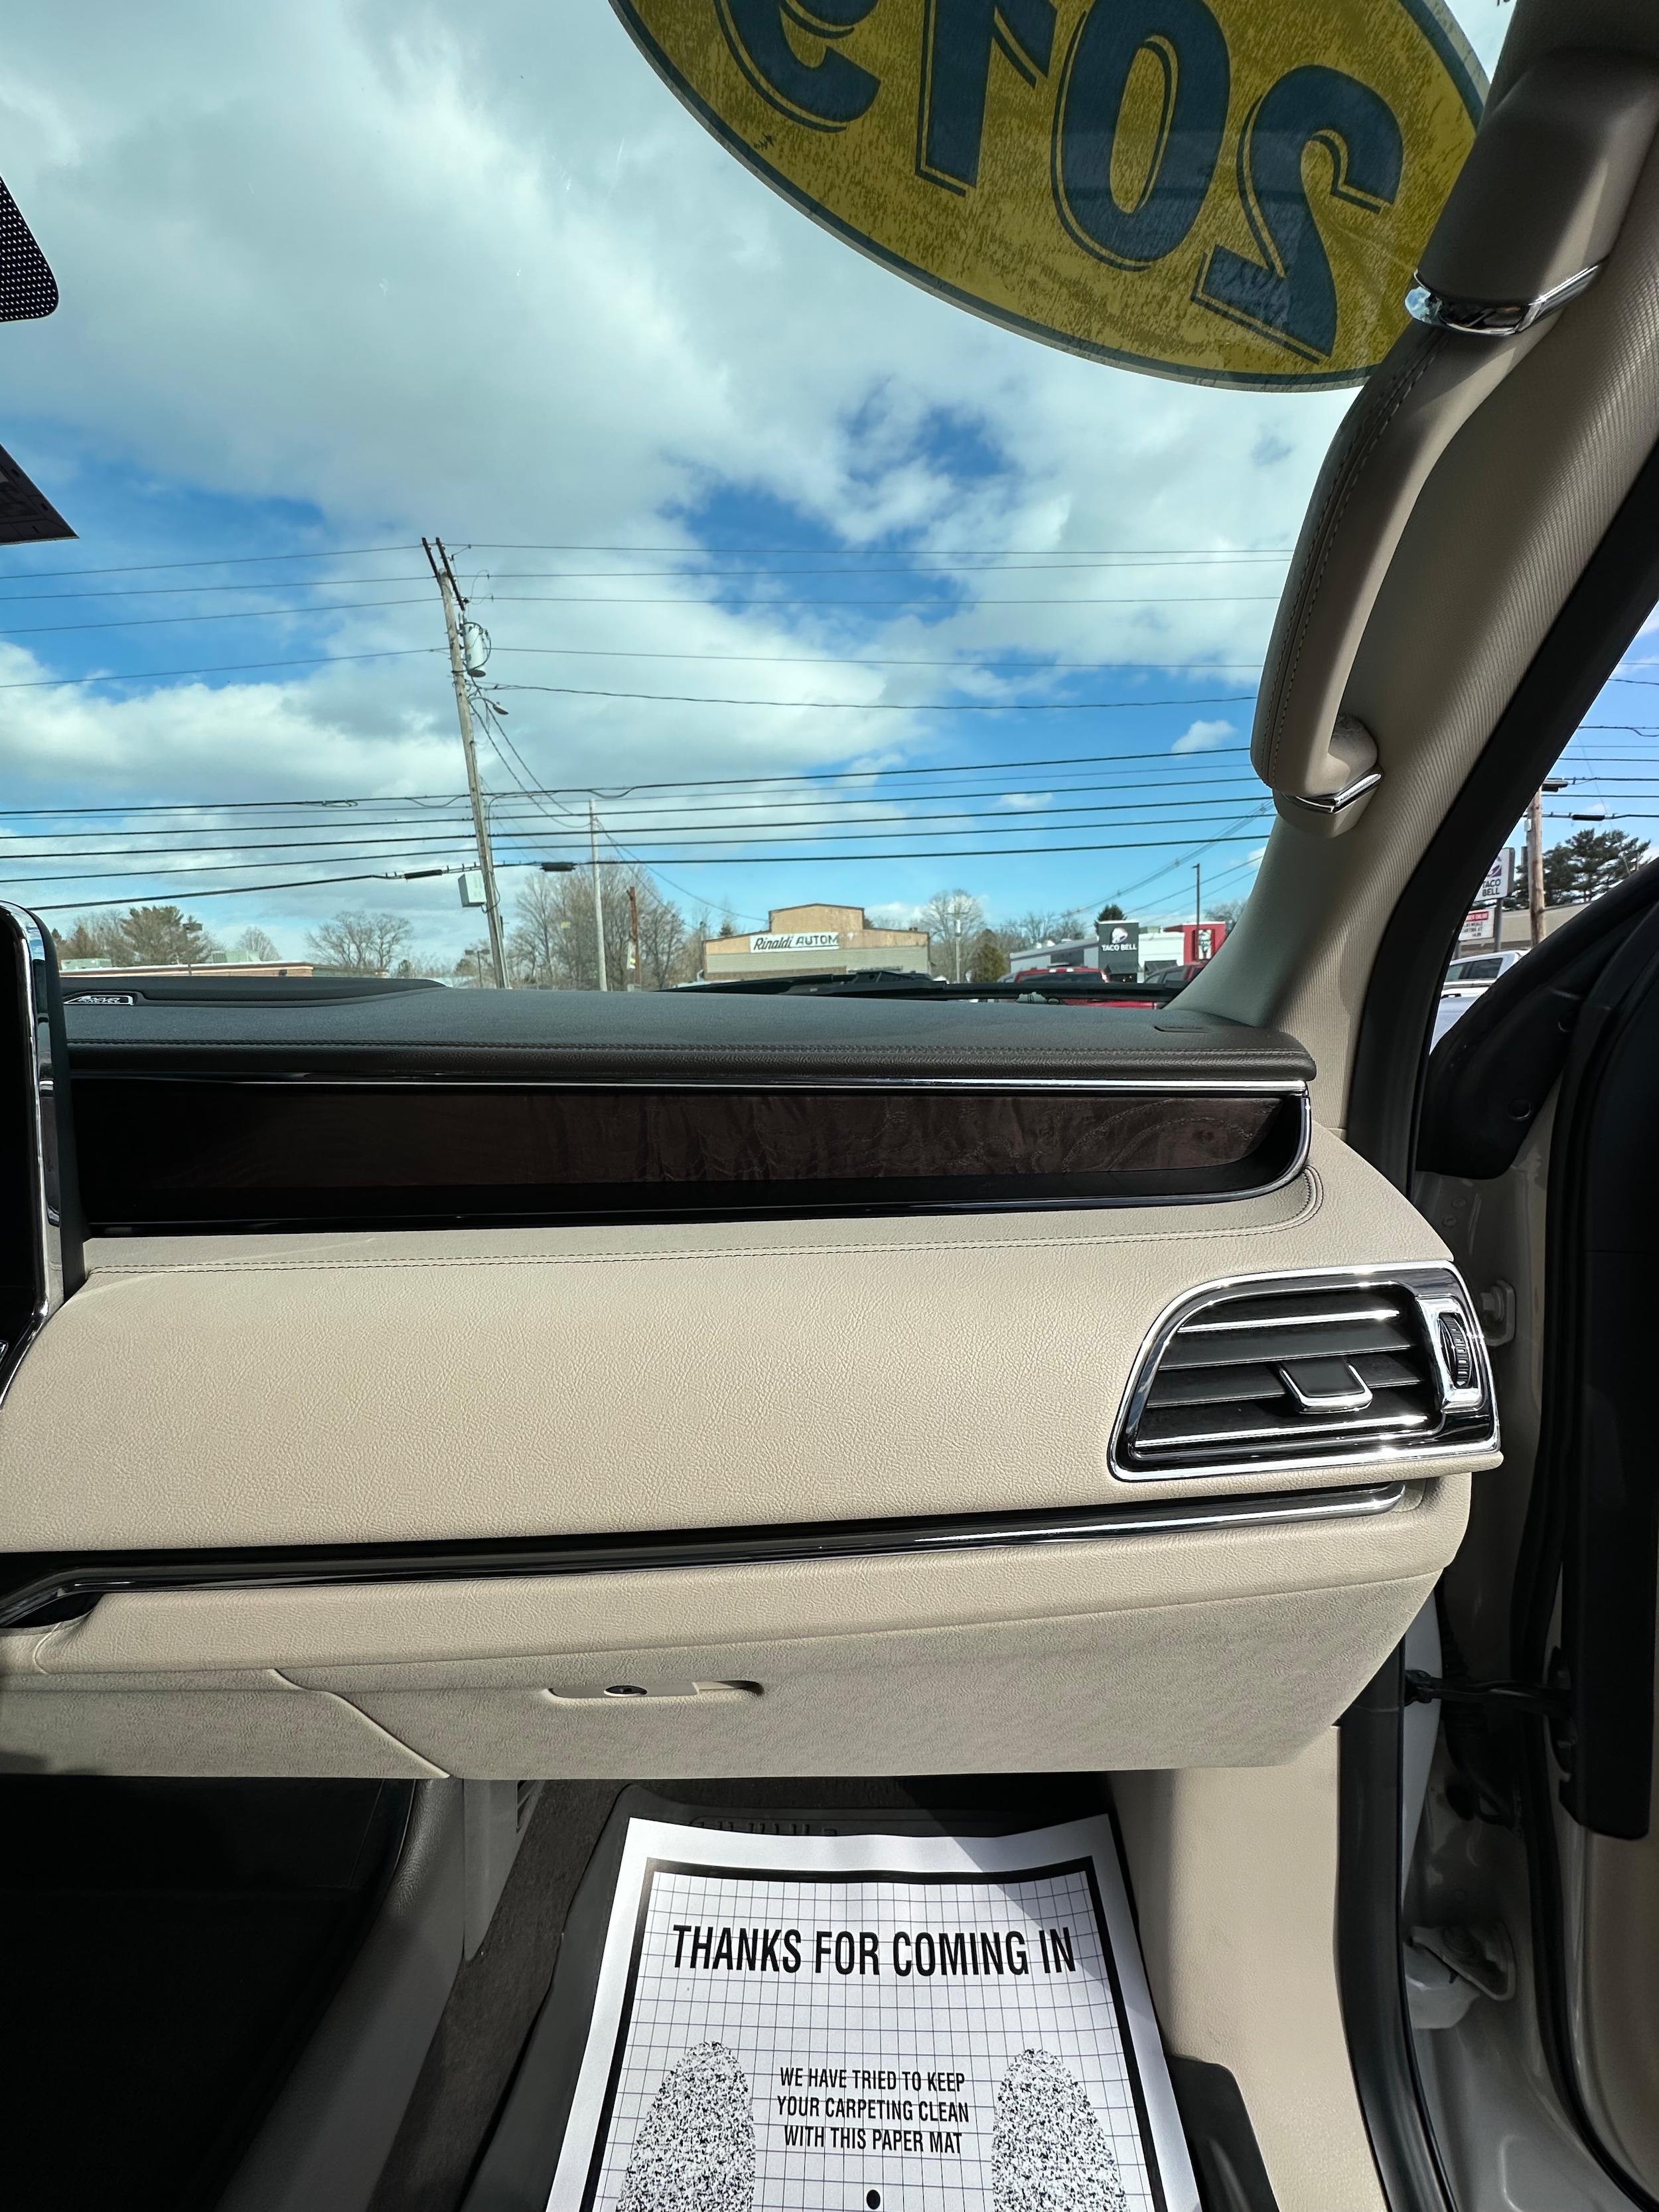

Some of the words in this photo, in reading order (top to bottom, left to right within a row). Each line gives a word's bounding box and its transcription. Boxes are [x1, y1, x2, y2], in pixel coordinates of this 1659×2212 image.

[1482, 879, 1501, 889] TACO
[1482, 887, 1500, 897] BELL
[753, 935, 794, 950] Rinaldi
[796, 935, 838, 945] AUTOM
[673, 1925, 802, 1973] THANKS
[815, 1931, 880, 1975] FOR
[893, 1931, 1029, 1976] COMING
[1039, 1927, 1076, 1974] IN
[780, 2067, 804, 2087] WE
[809, 2068, 847, 2088] HAVE
[852, 2070, 897, 2090] TRIED
[902, 2071, 922, 2091] TO
[928, 2072, 965, 2092] KEEP
[777, 2095, 820, 2117] YOUR
[825, 2097, 913, 2121] CARPETING
[918, 2101, 970, 2122] CLEAN
[784, 2126, 824, 2147] WITH
[830, 2127, 866, 2150] THIS
[872, 2129, 924, 2152] PAPER
[929, 2132, 962, 2154] MAT
